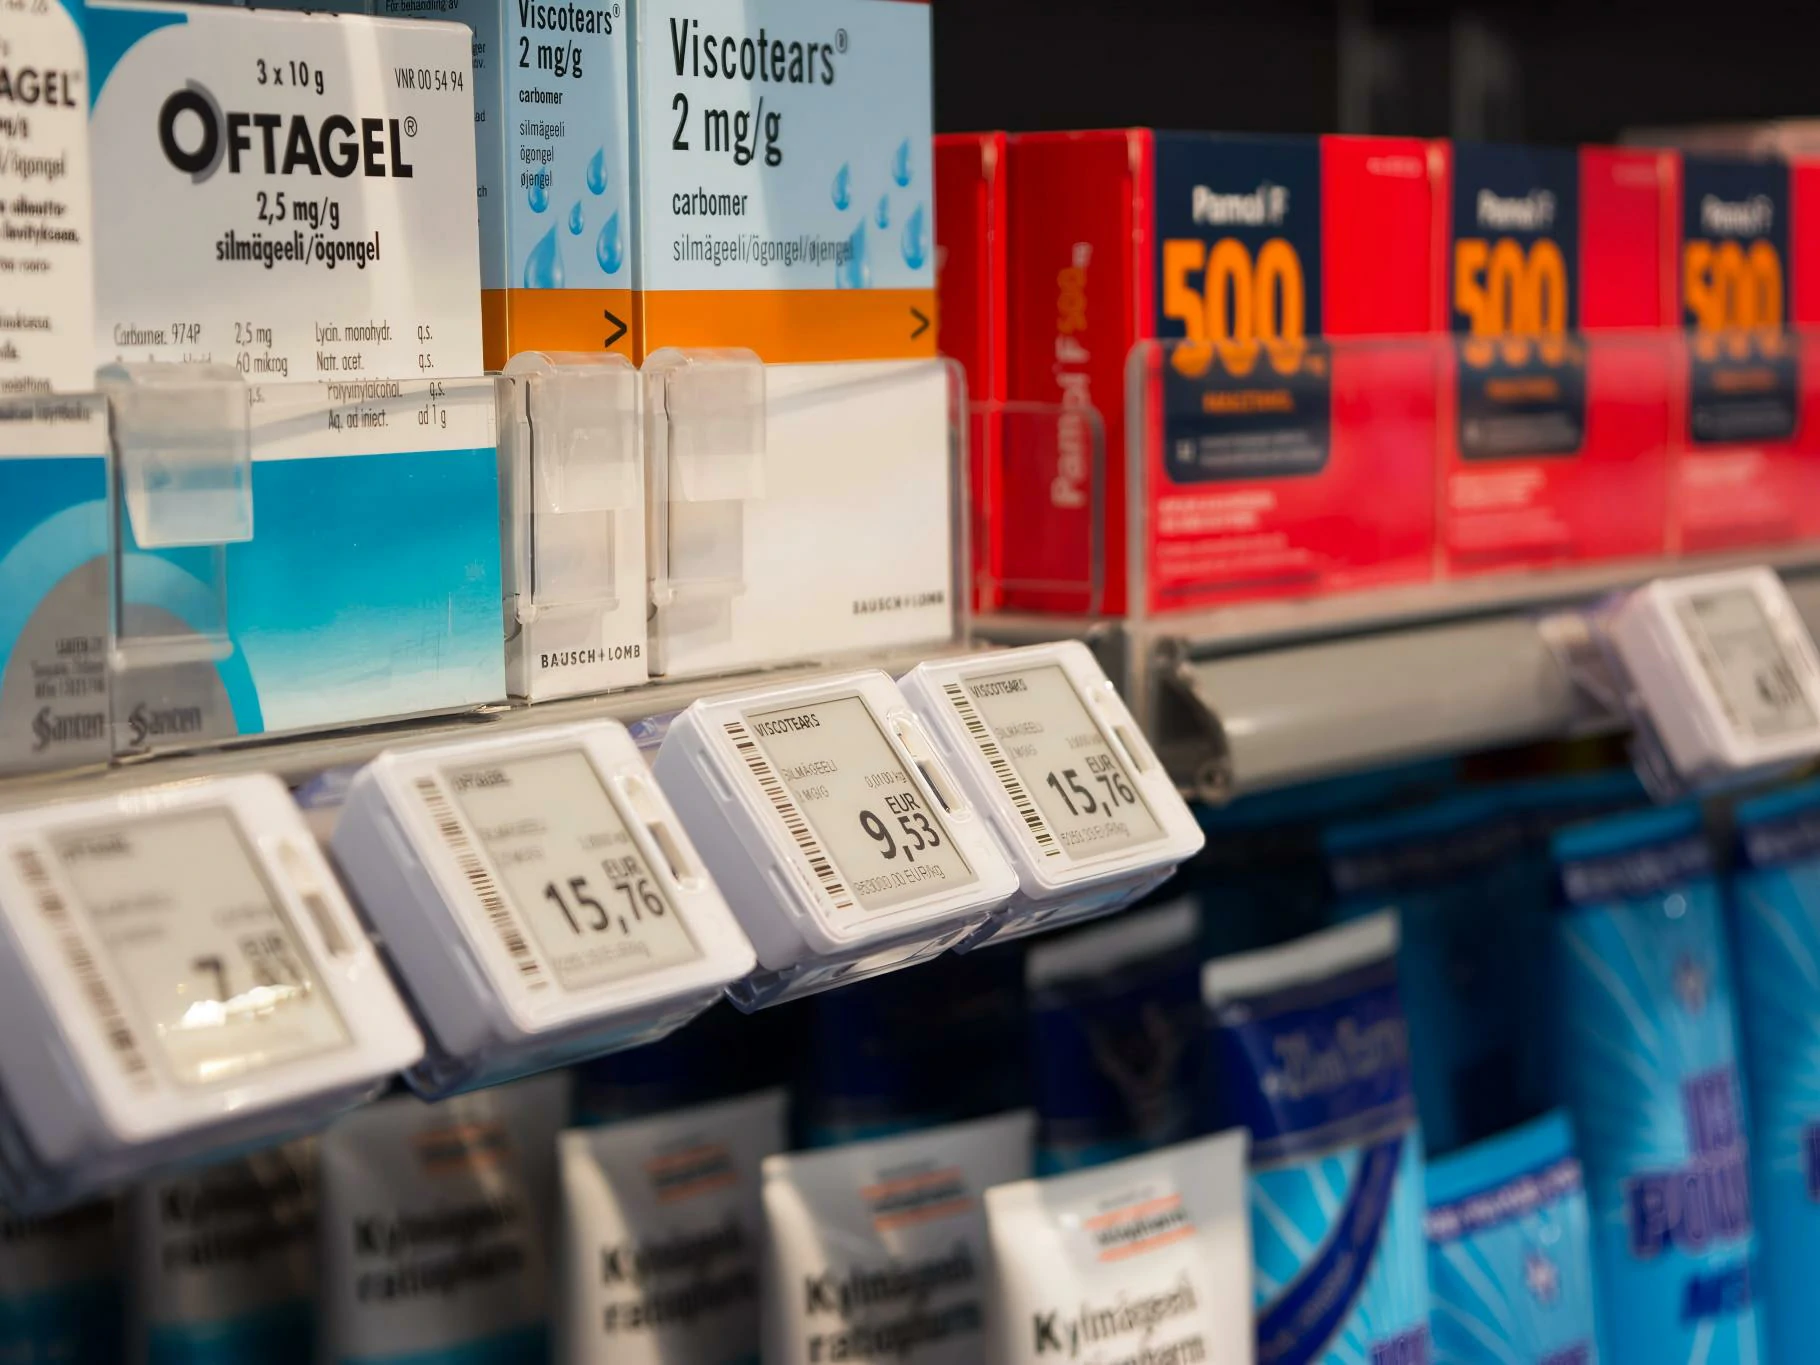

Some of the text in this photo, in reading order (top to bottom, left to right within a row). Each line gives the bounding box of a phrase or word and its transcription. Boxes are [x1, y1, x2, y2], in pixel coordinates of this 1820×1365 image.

[519, 36, 583, 78] 2 mg/g
[257, 59, 324, 94] 3 x 10 g
[395, 68, 463, 92] VNR 00 54 94
[519, 88, 563, 104] carbomer
[519, 120, 565, 140] silmägeeli
[672, 92, 783, 167] 2 mg/g
[520, 145, 554, 164] ögongel
[256, 191, 340, 230] 2,5 mg/g
[672, 186, 748, 217] carbomer
[216, 230, 380, 270] silmägeeli/ögongel
[1163, 237, 1305, 377] 500
[1456, 238, 1566, 368] 500
[1684, 240, 1784, 362] 500
[172, 323, 200, 345] 974P
[234, 322, 272, 349] 2,5 mg
[345, 320, 392, 345] monohydr.
[418, 325, 433, 344] q.s.
[236, 352, 250, 373] 60
[254, 352, 288, 377] mikrog
[316, 351, 365, 371] Natr. acet.
[419, 353, 434, 373] q.s.
[347, 407, 358, 429] ad
[418, 404, 447, 428] ad 1 g
[753, 713, 820, 737] VISCOTEARS
[1085, 754, 1116, 774] EUR
[884, 792, 920, 815] EUR
[1046, 768, 1135, 818] 15,76
[859, 810, 941, 862] 9,53
[545, 875, 665, 935] 15,76
